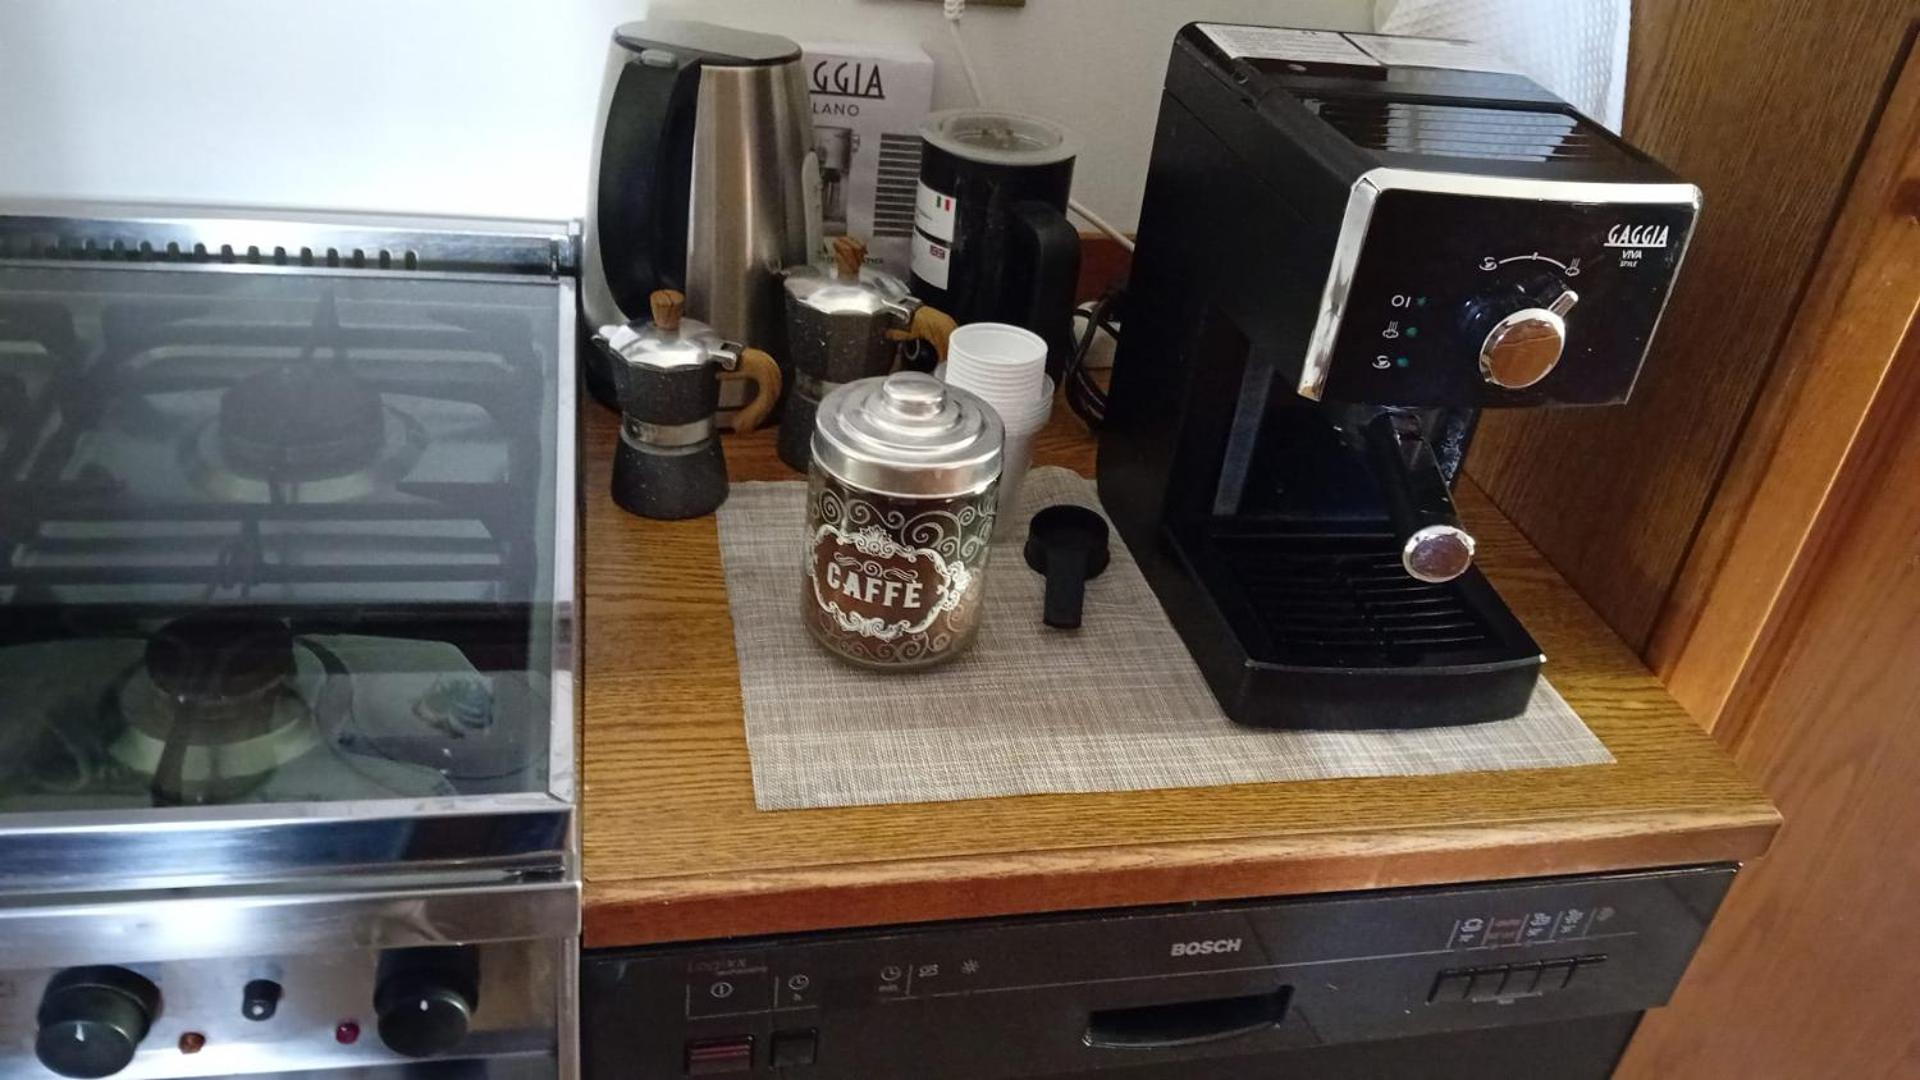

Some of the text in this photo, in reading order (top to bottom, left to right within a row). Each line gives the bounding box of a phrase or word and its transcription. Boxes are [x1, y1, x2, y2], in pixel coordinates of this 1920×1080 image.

[808, 60, 885, 99] GGIA
[812, 102, 860, 117] LANO
[1604, 223, 1669, 247] GAGGIA
[1622, 249, 1642, 259] VIVA
[1170, 938, 1242, 957] BOSCH
